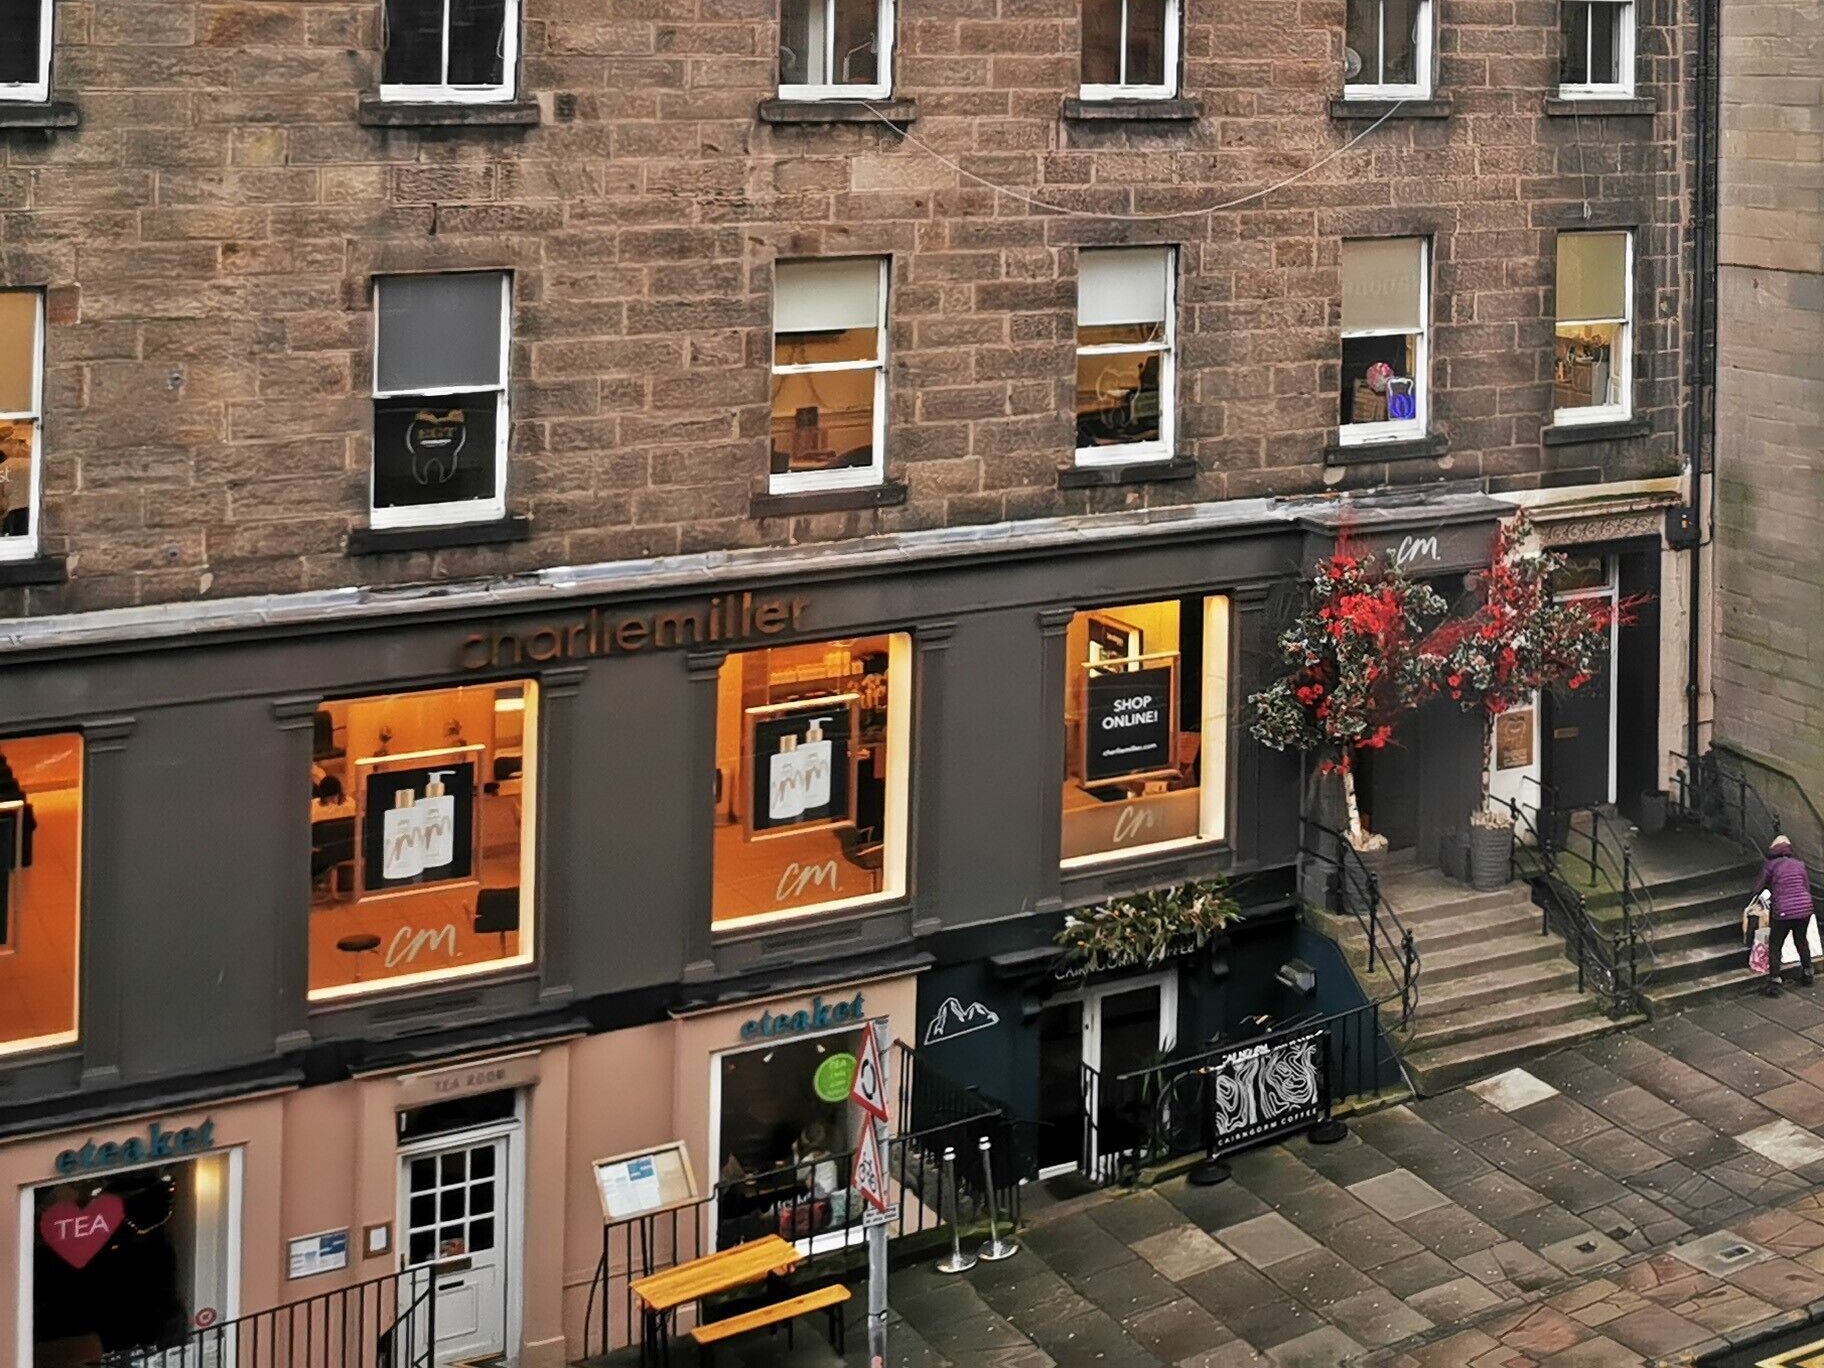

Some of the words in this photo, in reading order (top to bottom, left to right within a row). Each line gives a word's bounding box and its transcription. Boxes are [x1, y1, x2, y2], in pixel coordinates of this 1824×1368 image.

[461, 591, 811, 669] charliemiller
[1102, 710, 1159, 730] ONLINE!
[1113, 695, 1152, 713] SHOP
[740, 991, 865, 1041] eteaket
[55, 1115, 216, 1177] eteaket
[54, 1213, 110, 1241] TEA
